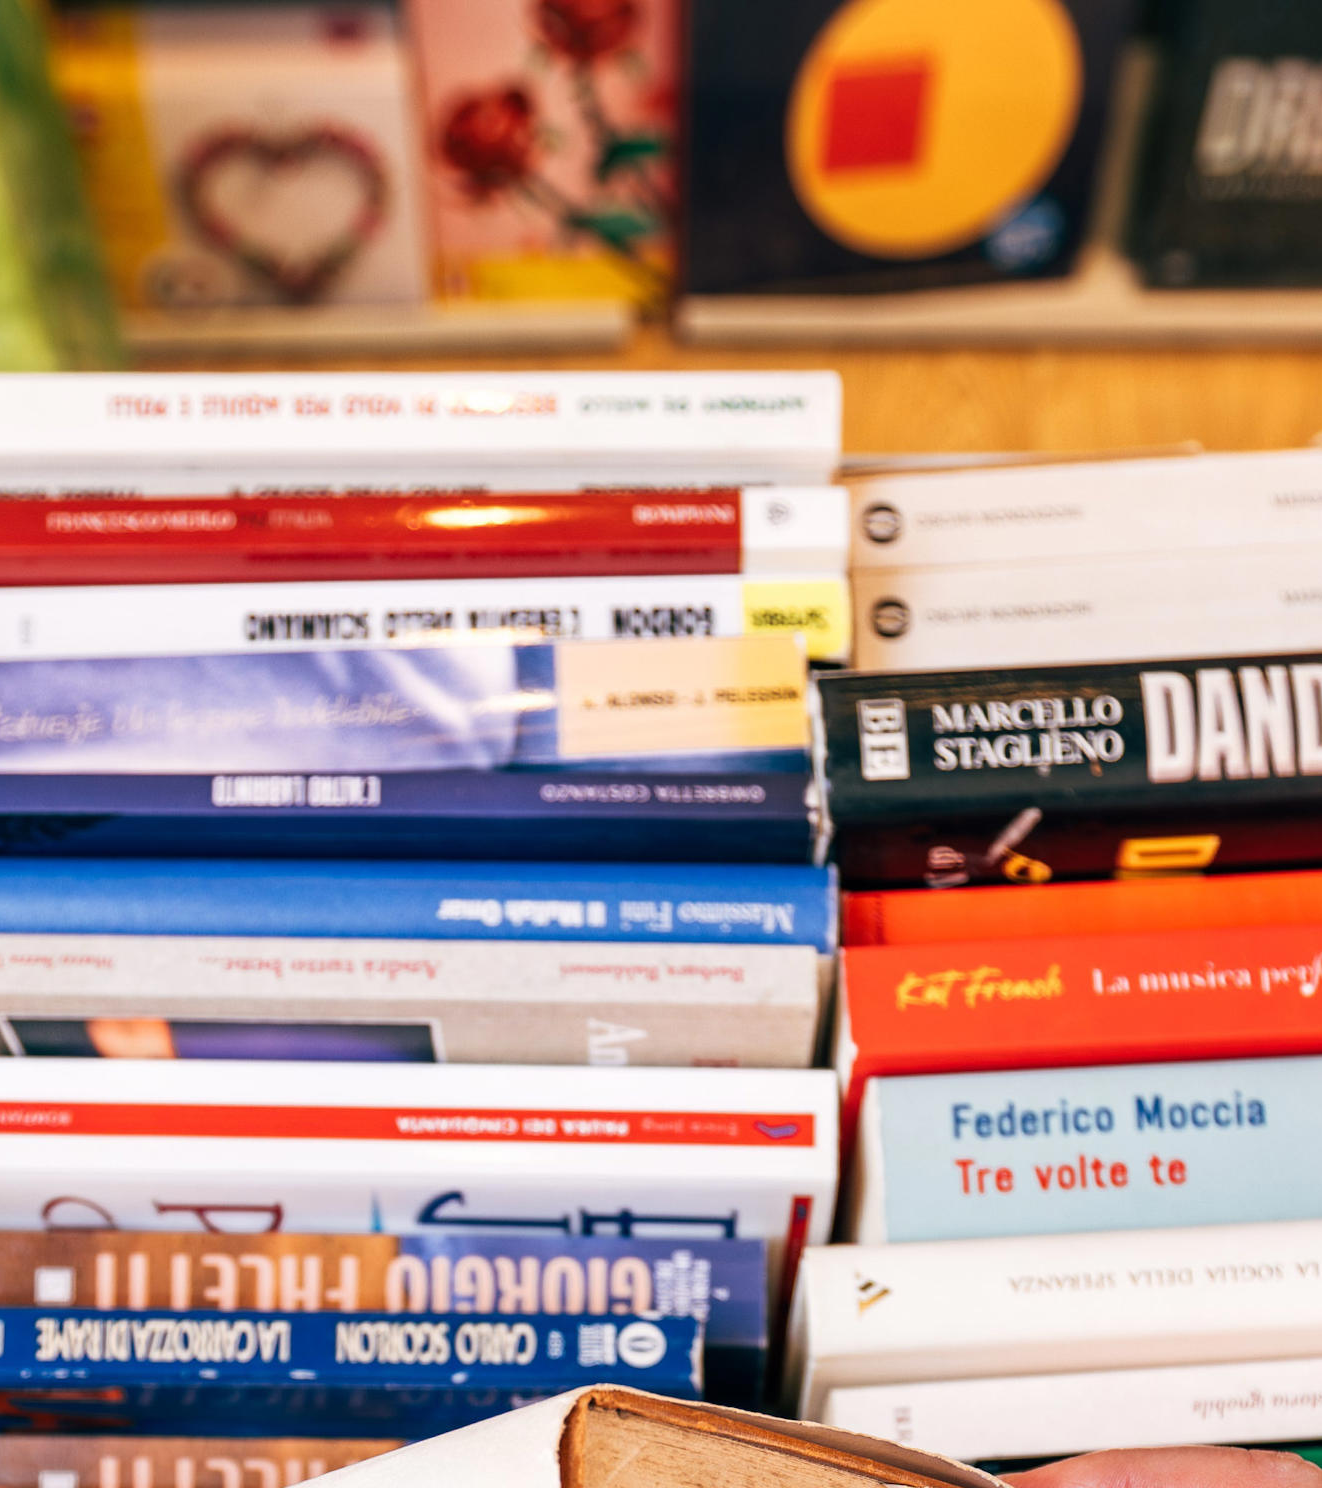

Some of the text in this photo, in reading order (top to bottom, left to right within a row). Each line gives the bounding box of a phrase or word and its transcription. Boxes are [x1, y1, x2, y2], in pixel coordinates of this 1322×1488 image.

[931, 696, 1125, 733] MARCELLO
[932, 729, 1125, 769] STAGLIENO
[1091, 965, 1129, 996] La
[1134, 957, 1251, 996] musica
[950, 1089, 1269, 1141] Federico Moccia
[954, 1152, 1189, 1197] Tre volte te
[92, 1252, 652, 1315] GIORGIO FALETTI
[334, 1321, 538, 1365] CARLO SGORLON
